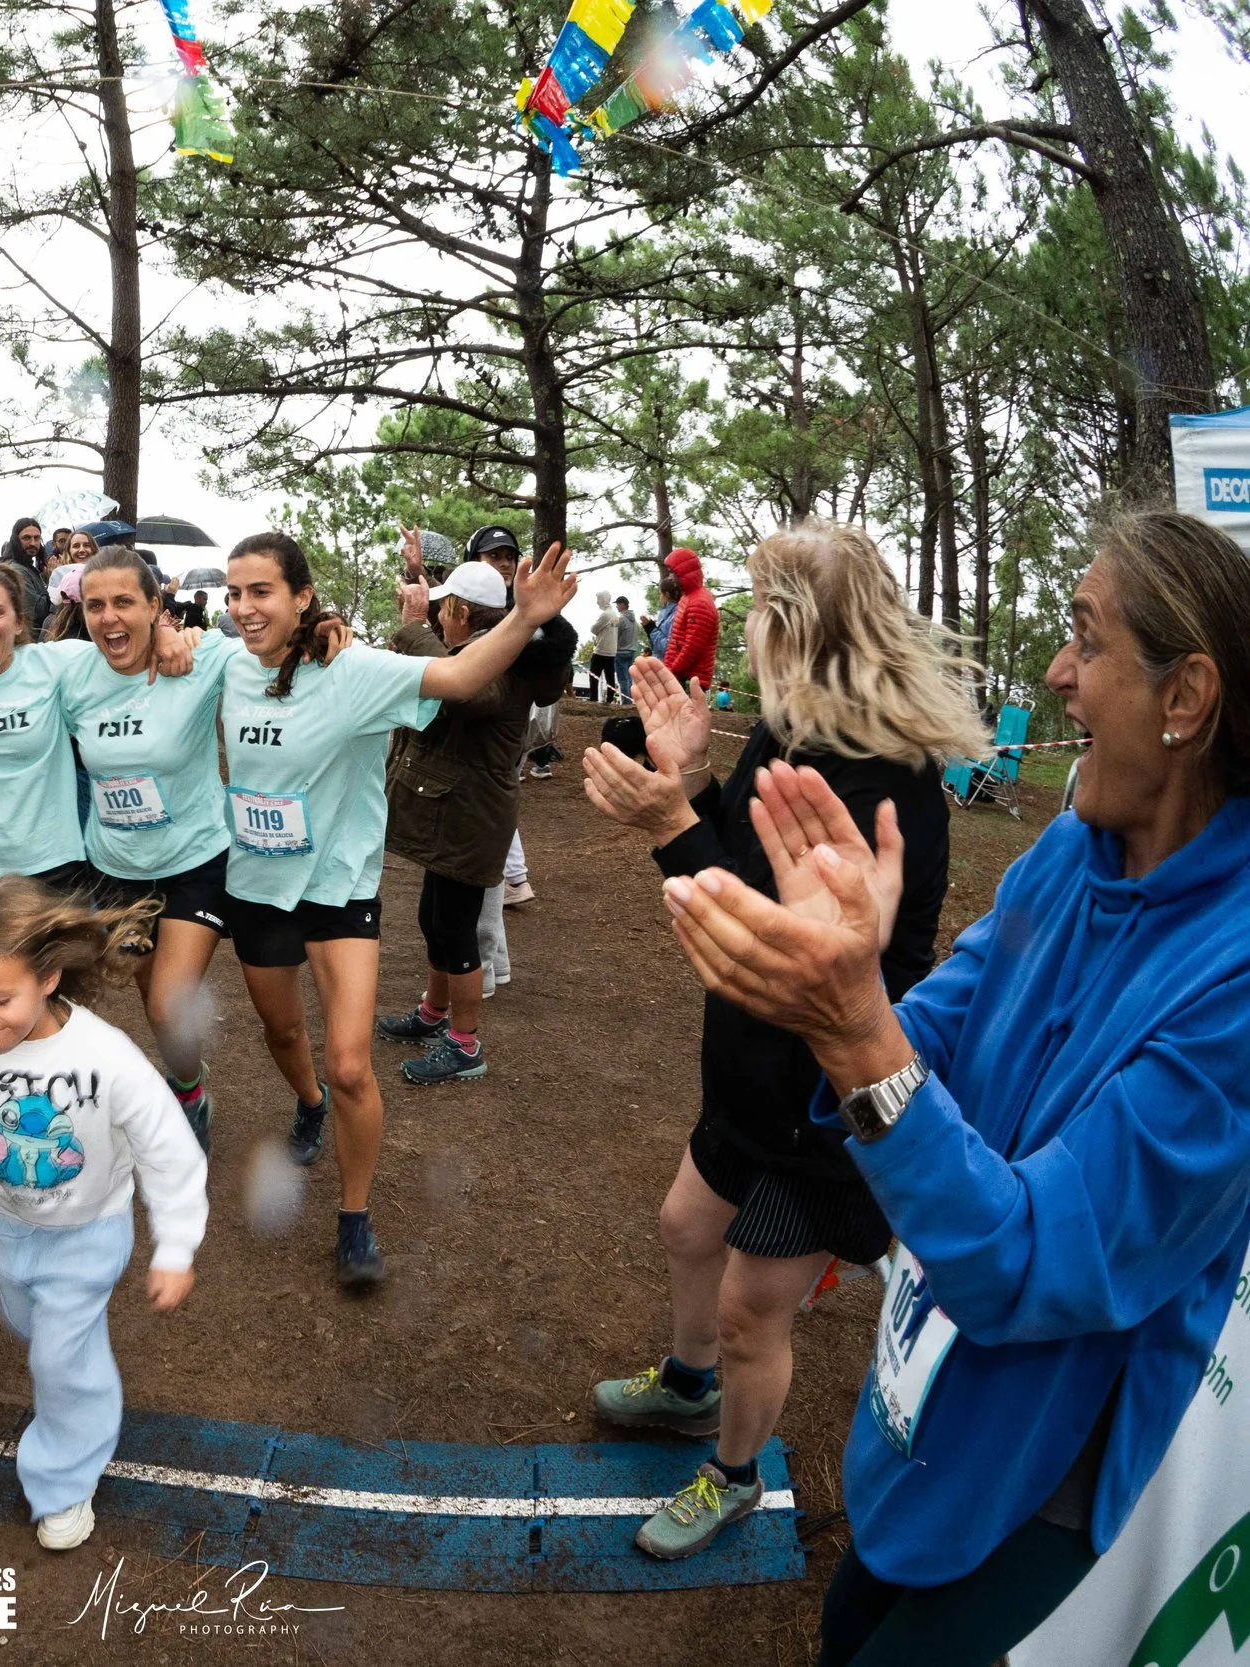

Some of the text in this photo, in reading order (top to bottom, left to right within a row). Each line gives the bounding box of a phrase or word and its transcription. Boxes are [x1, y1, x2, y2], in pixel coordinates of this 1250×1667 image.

[1211, 477, 1250, 503] DECA
[98, 714, 143, 738] raíz
[239, 720, 283, 746] raíz
[103, 787, 143, 809] 1120
[246, 806, 284, 831] 1119
